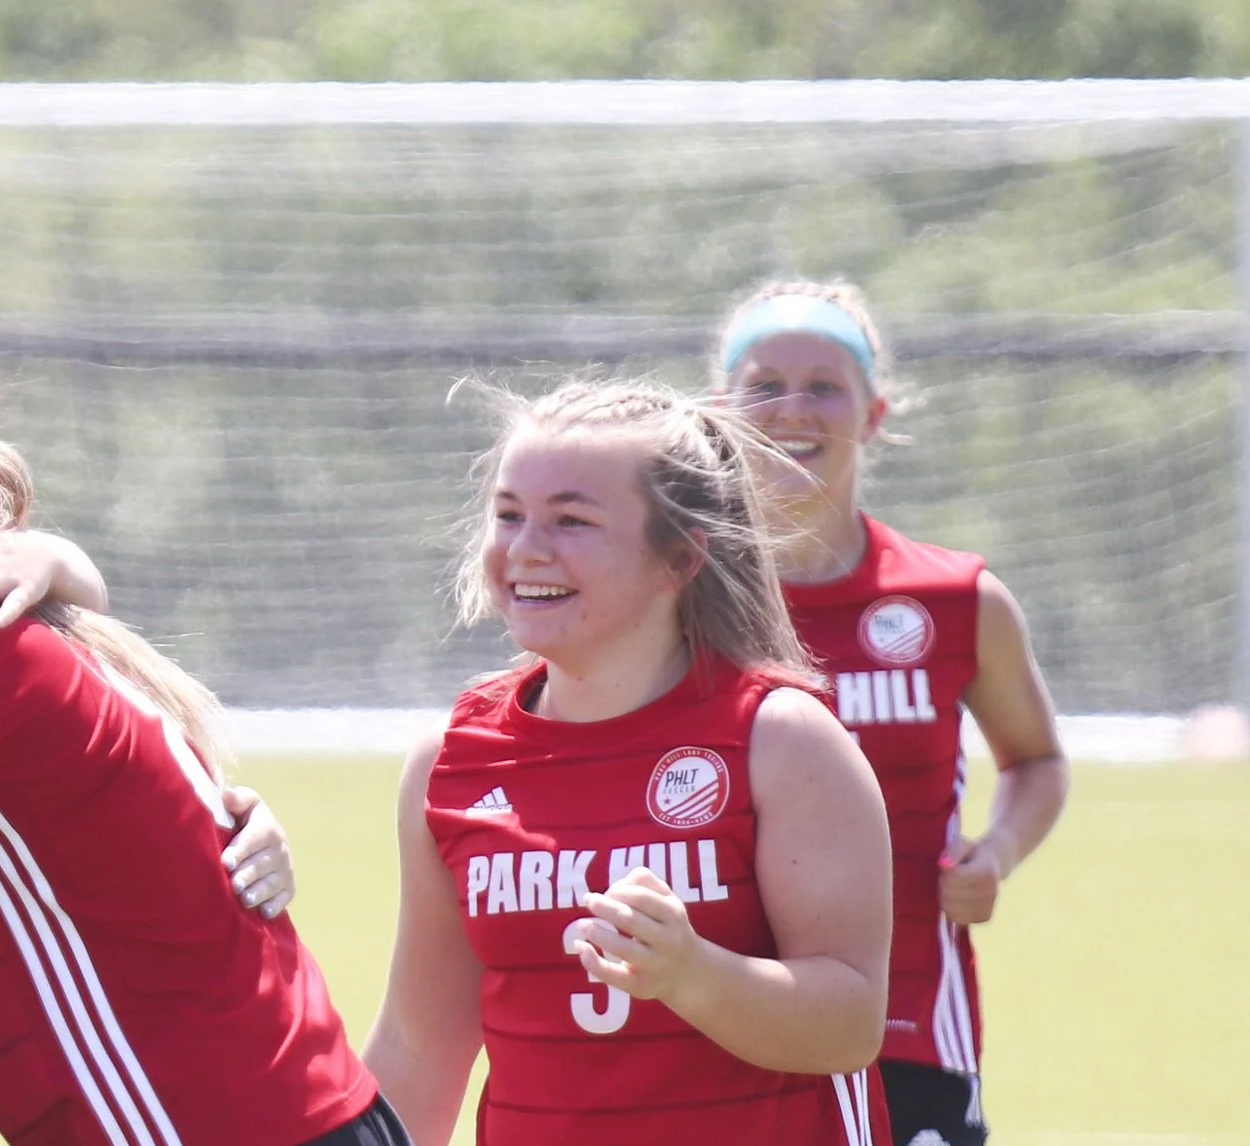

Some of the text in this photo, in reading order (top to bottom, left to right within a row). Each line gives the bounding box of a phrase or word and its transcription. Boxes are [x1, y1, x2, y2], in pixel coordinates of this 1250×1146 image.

[837, 668, 937, 724] HILL
[664, 767, 700, 788] PHLT
[467, 849, 597, 917] PARK
